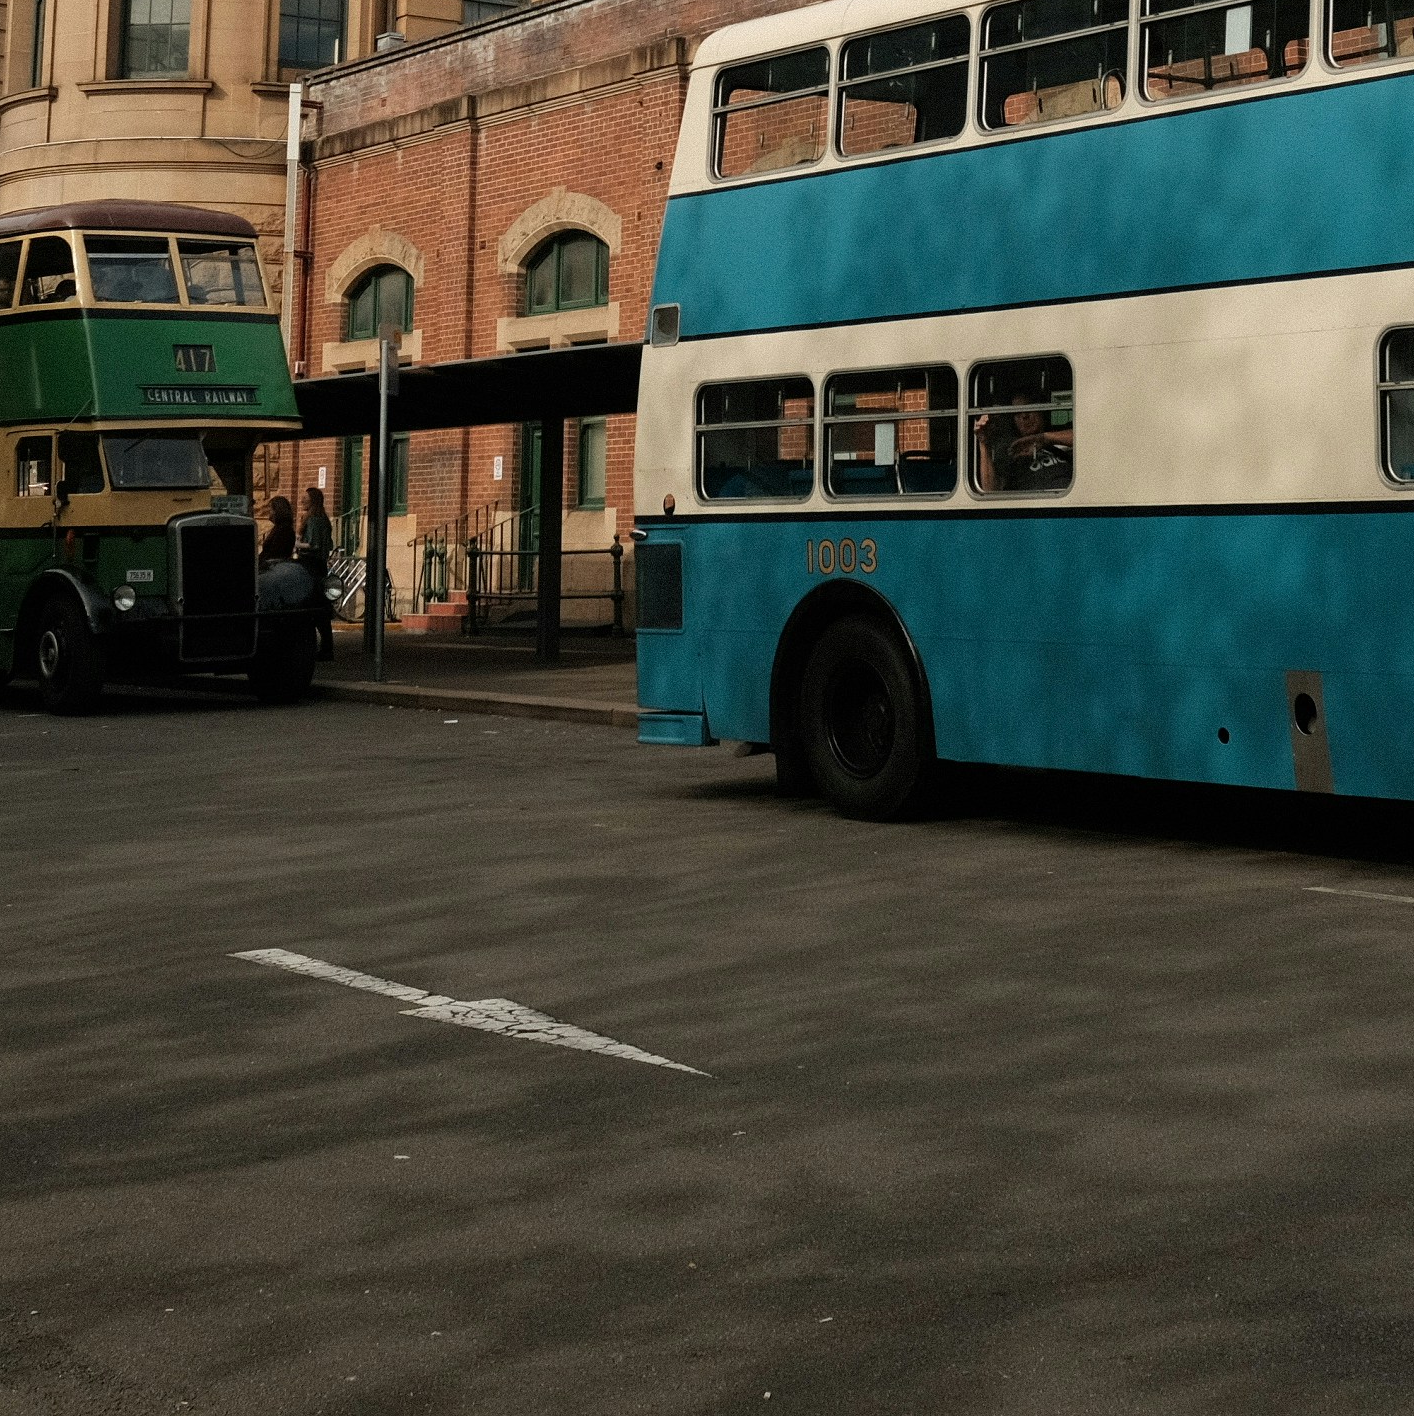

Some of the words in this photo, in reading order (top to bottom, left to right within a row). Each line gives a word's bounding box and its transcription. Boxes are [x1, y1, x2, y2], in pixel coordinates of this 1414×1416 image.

[176, 349, 210, 371] 417
[147, 389, 197, 403] CENTRAL
[204, 391, 247, 403] RAILWAY
[807, 537, 877, 574] 1003
